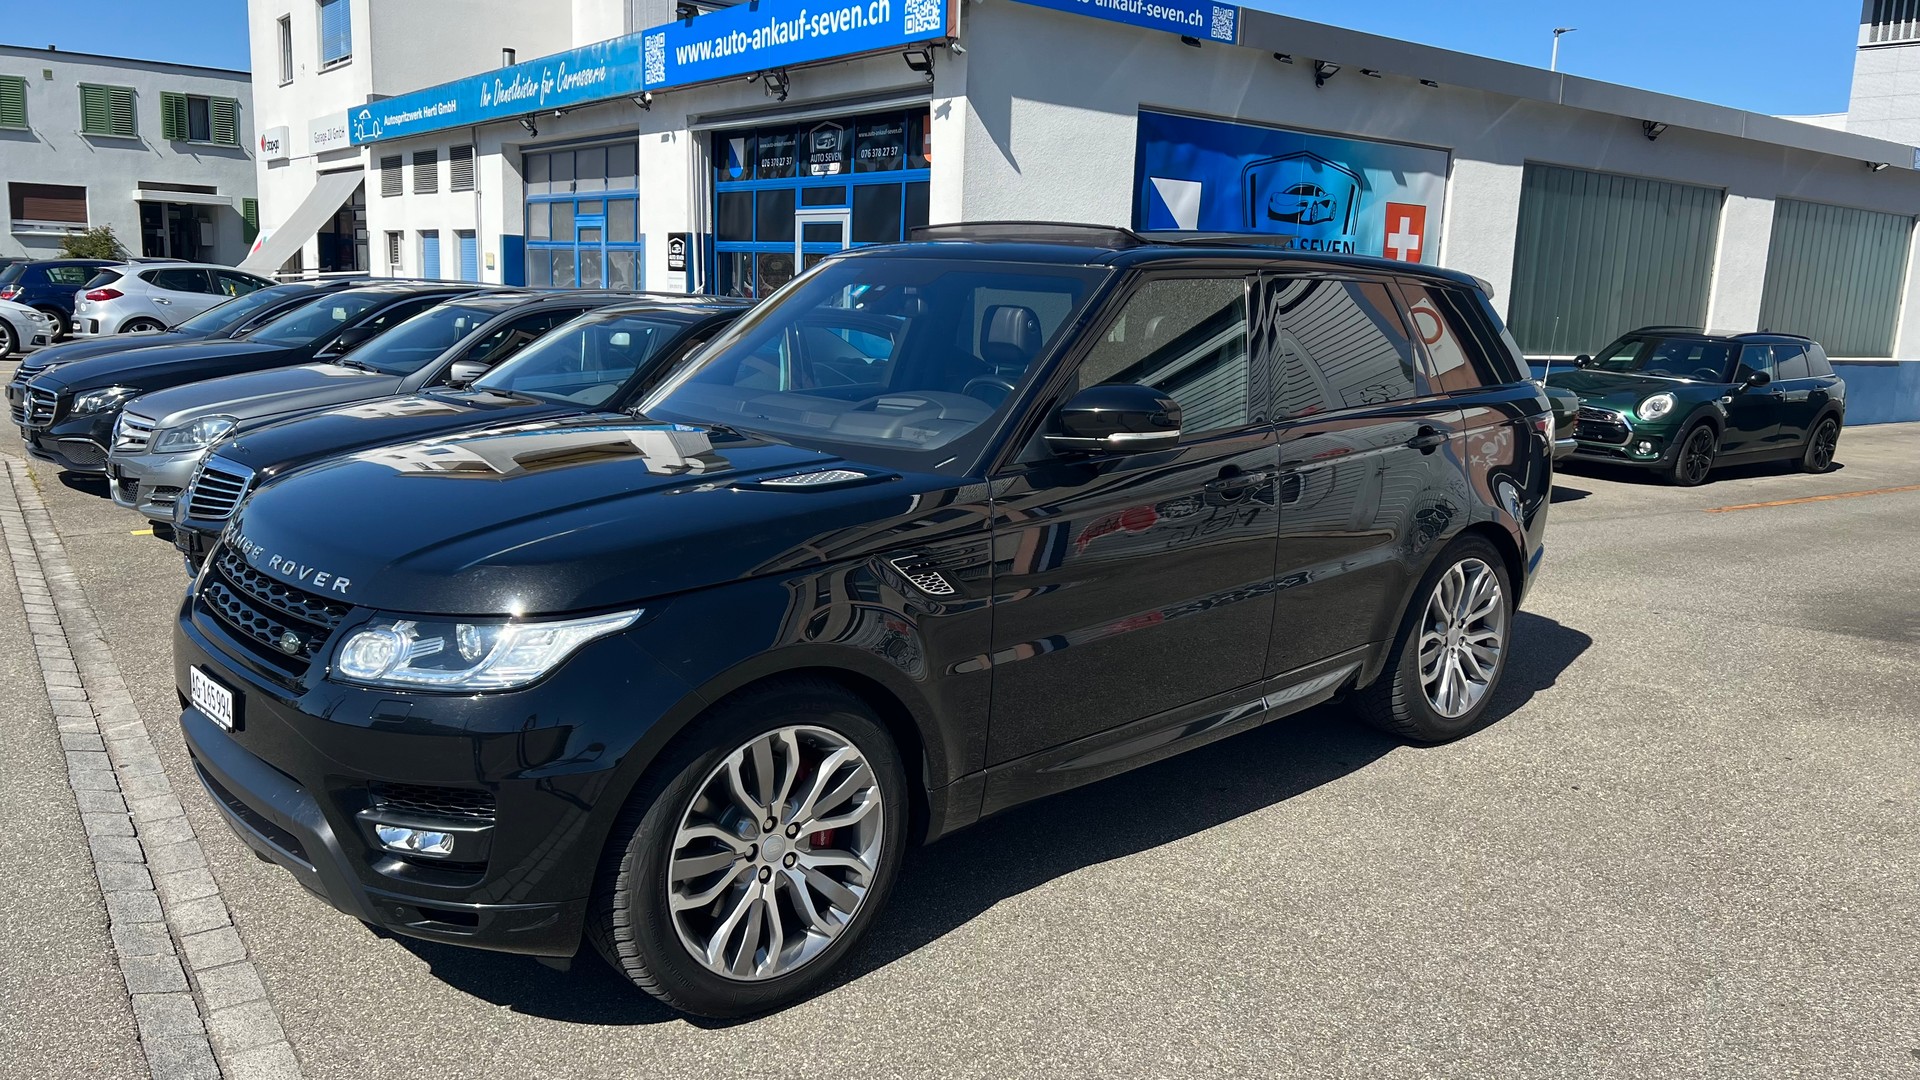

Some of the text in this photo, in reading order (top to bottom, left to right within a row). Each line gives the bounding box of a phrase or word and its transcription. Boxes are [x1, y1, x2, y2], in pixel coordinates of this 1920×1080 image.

[676, 0, 890, 66] www.auto-ankauf-seven.ch
[480, 58, 607, 108] Ihr Dienstleister für Carrosserie
[383, 99, 456, 126] Autospritzwerk Herti GmbH
[786, 156, 793, 165] 37
[810, 151, 842, 163] AUTO SEVEN
[860, 146, 898, 158] 076 378 27 37
[268, 554, 351, 594] ROVER
